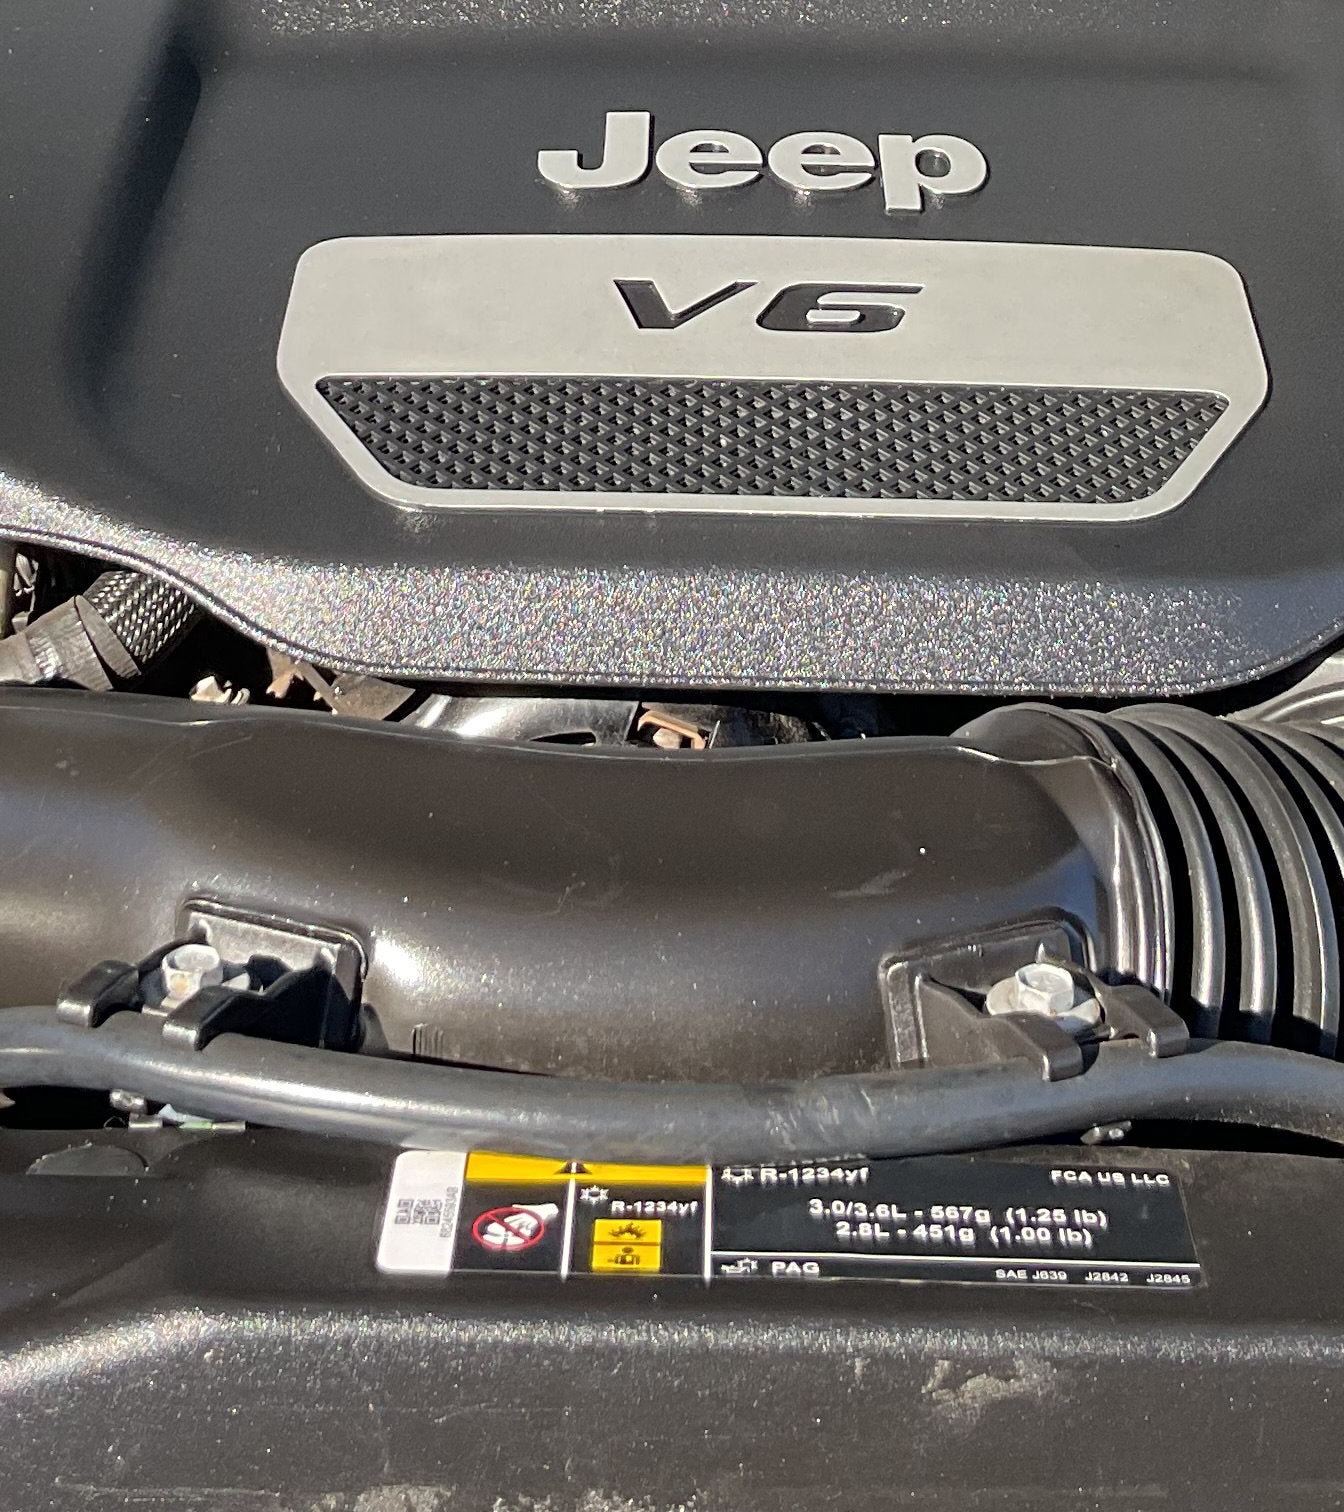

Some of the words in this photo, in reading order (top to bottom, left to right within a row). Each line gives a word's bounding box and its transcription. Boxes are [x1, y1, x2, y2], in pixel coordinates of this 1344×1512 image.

[537, 109, 989, 214] Jeep
[612, 278, 926, 334] V6
[760, 1167, 869, 1183] R-1234yf
[1050, 1169, 1093, 1184] FCA
[1096, 1171, 1125, 1185] US
[1130, 1172, 1171, 1186] LLC
[611, 1200, 699, 1216] R-1234yf
[807, 1198, 907, 1220] 3.0/3.6L
[930, 1205, 991, 1225] 567g
[1005, 1207, 1067, 1226] (1.25
[1073, 1207, 1108, 1228] lb)
[835, 1220, 890, 1238] 2.8L
[912, 1224, 975, 1244] 451g
[989, 1226, 1051, 1245] (1.00
[1059, 1228, 1093, 1247] lb)
[771, 1261, 820, 1276] PAG
[995, 1269, 1028, 1281] SAE
[1031, 1269, 1068, 1282] J639
[1084, 1271, 1129, 1284] J2842
[1146, 1273, 1191, 1286] J2845
